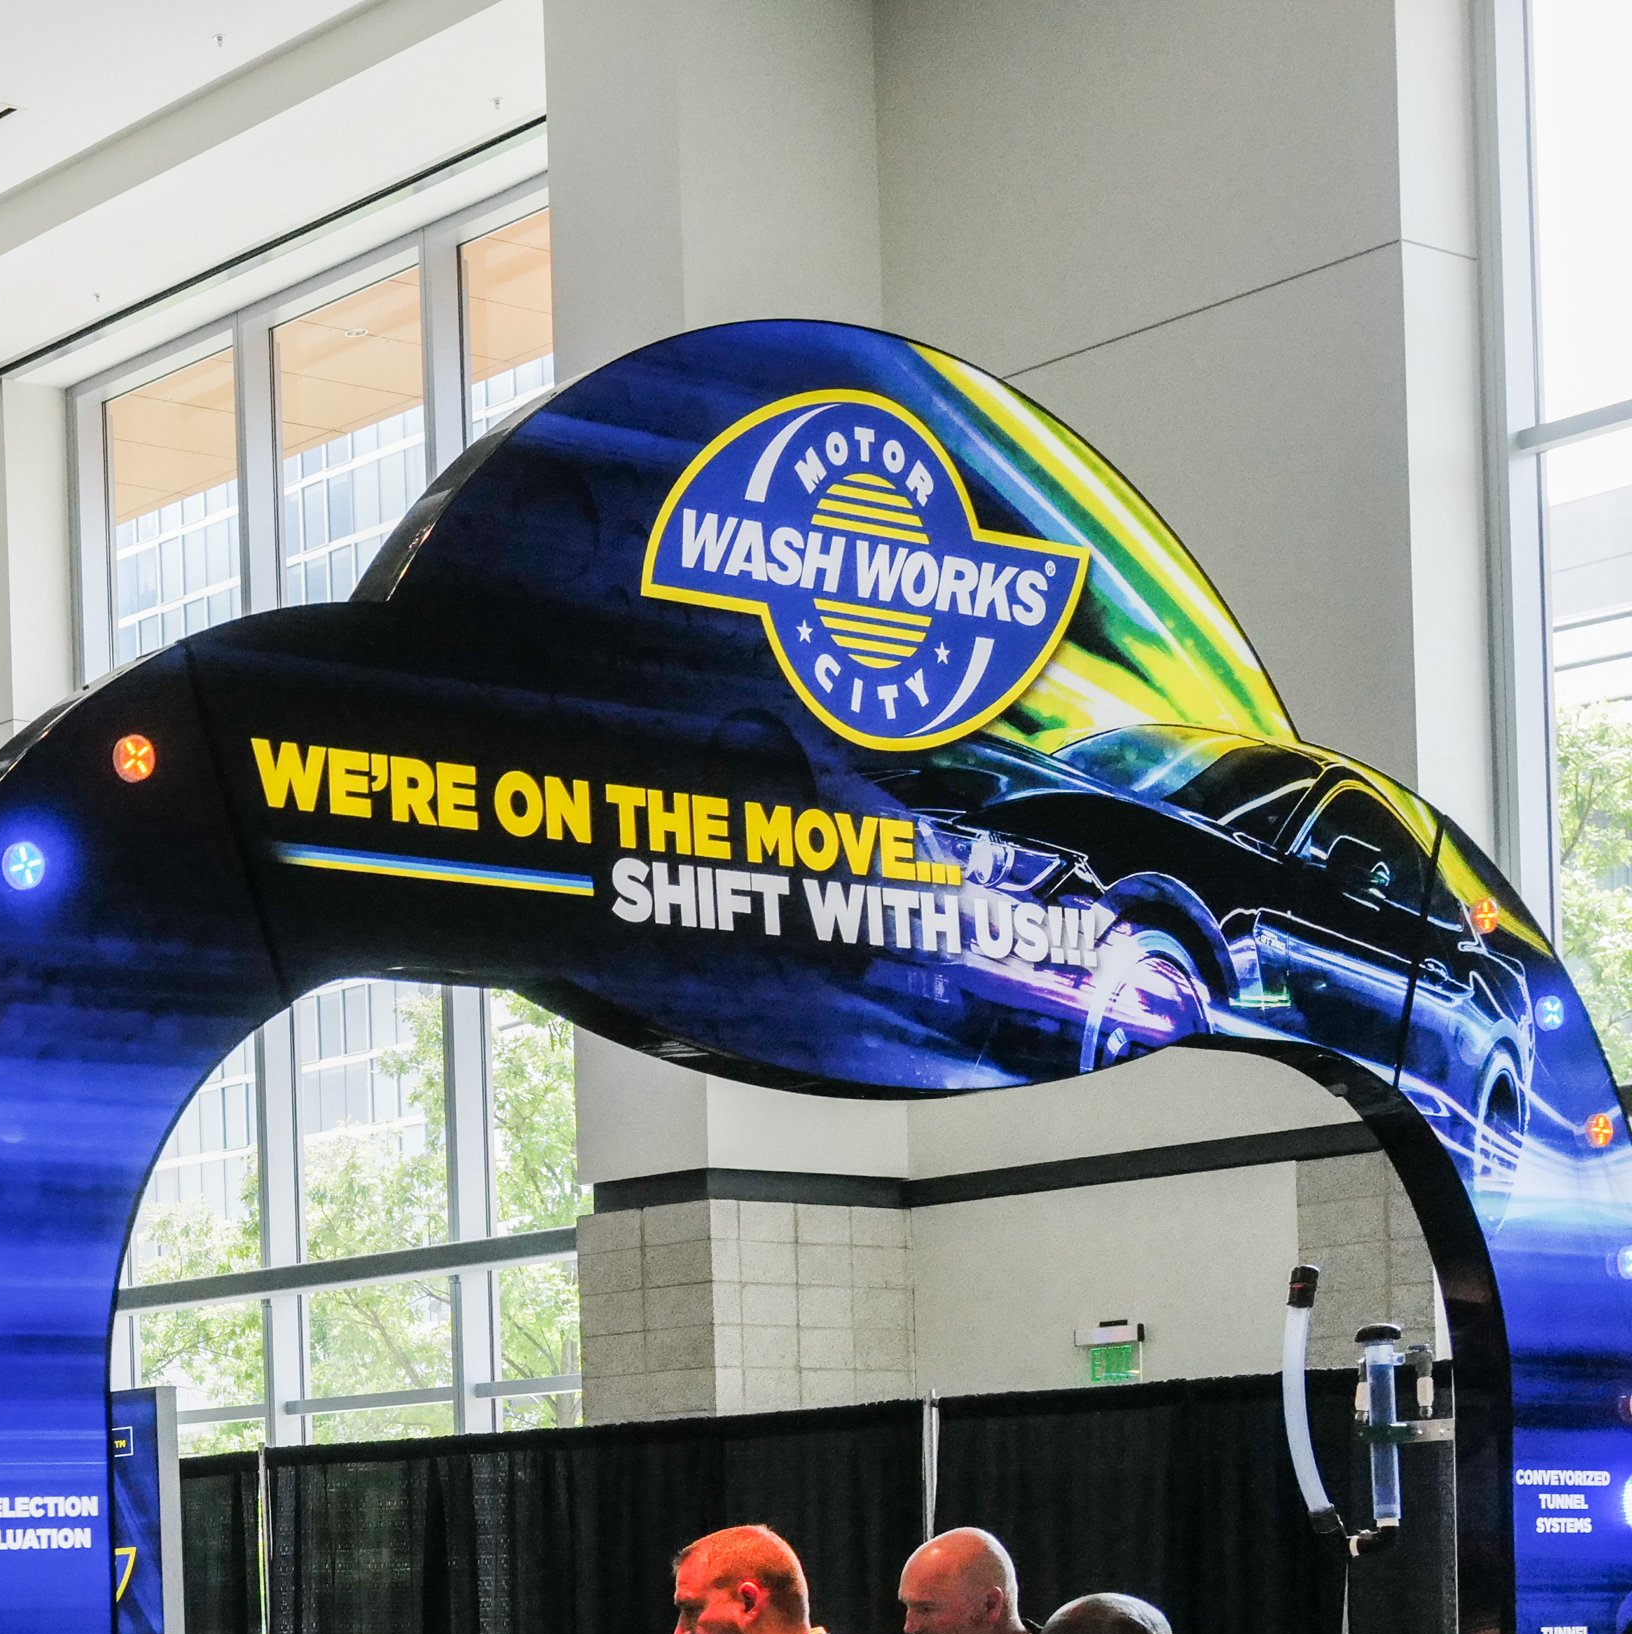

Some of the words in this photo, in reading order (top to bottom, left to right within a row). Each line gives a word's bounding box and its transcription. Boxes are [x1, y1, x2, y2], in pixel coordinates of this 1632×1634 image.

[793, 426, 935, 507] MOTOR
[680, 508, 846, 594] WASH
[814, 653, 931, 720] CITY
[493, 770, 594, 846] ON
[604, 785, 734, 861] THE
[744, 803, 963, 887] MOVE...
[610, 859, 790, 939] SHIFT
[802, 877, 961, 960] WITH
[1515, 1469, 1611, 1487] CONVEYORIZED
[1539, 1493, 1588, 1510] TUNNEL
[1536, 1516, 1592, 1534] SYSTEMS
